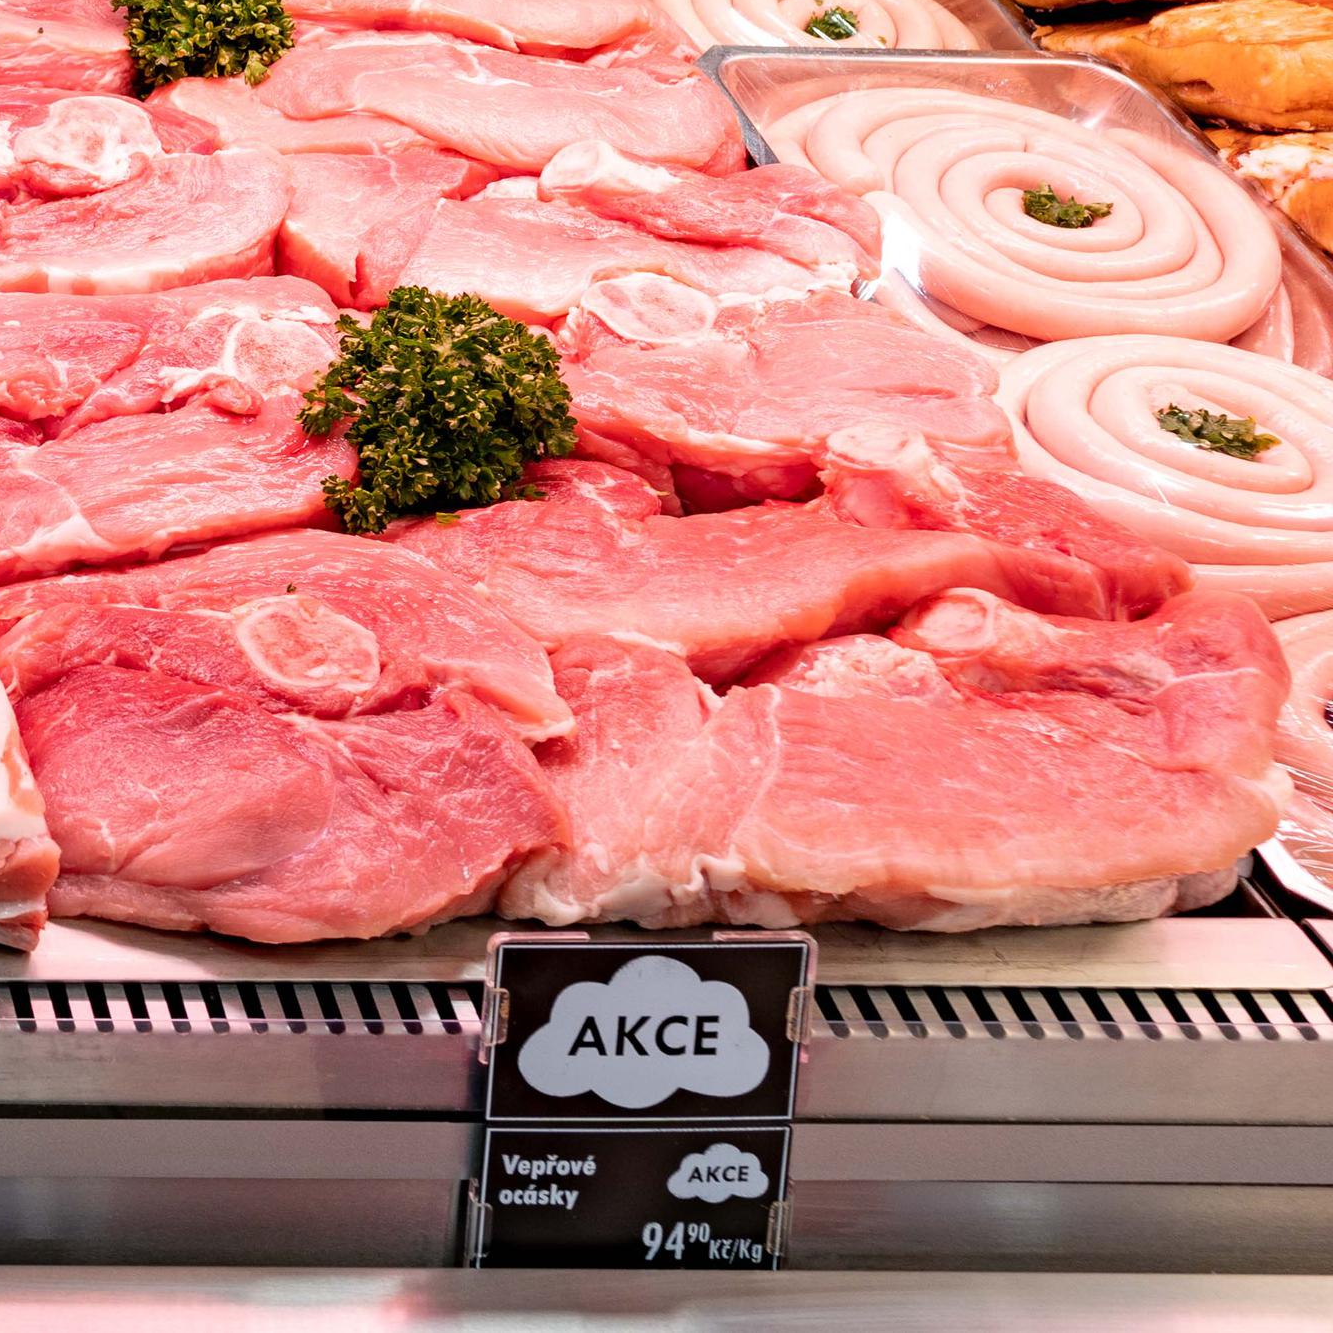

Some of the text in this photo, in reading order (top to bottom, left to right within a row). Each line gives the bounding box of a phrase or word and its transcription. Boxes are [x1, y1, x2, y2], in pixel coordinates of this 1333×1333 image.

[568, 1015, 719, 1056] AKCE
[501, 1154, 597, 1179] Vepřové
[687, 1166, 749, 1183] AKCE
[499, 1183, 579, 1209] ocásky
[709, 1240, 762, 1263] Kč/Kg
